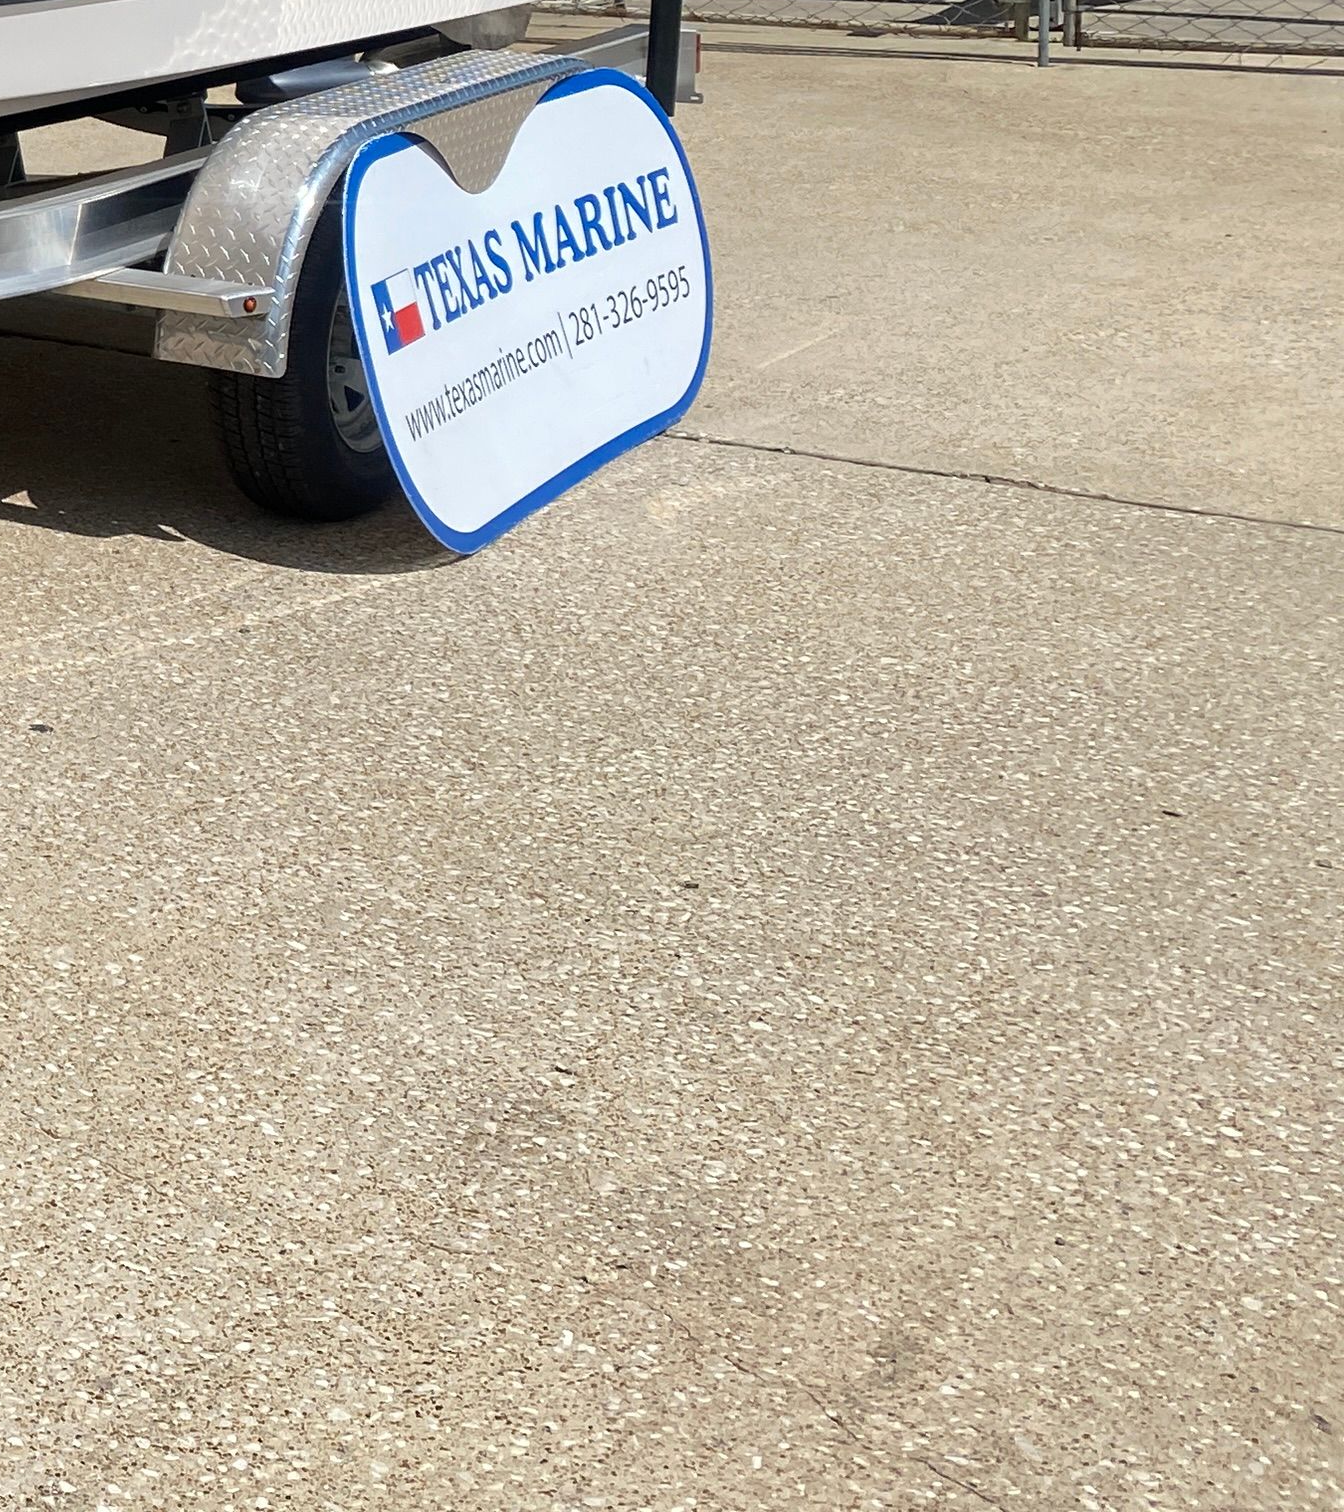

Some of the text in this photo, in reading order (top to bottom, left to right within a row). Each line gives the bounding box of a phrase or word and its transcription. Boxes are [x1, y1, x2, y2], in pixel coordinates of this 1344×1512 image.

[413, 167, 678, 330] TEXAS MARINE
[405, 329, 564, 442] www.texasmarine.com
[568, 265, 691, 346] 281-326-9595
